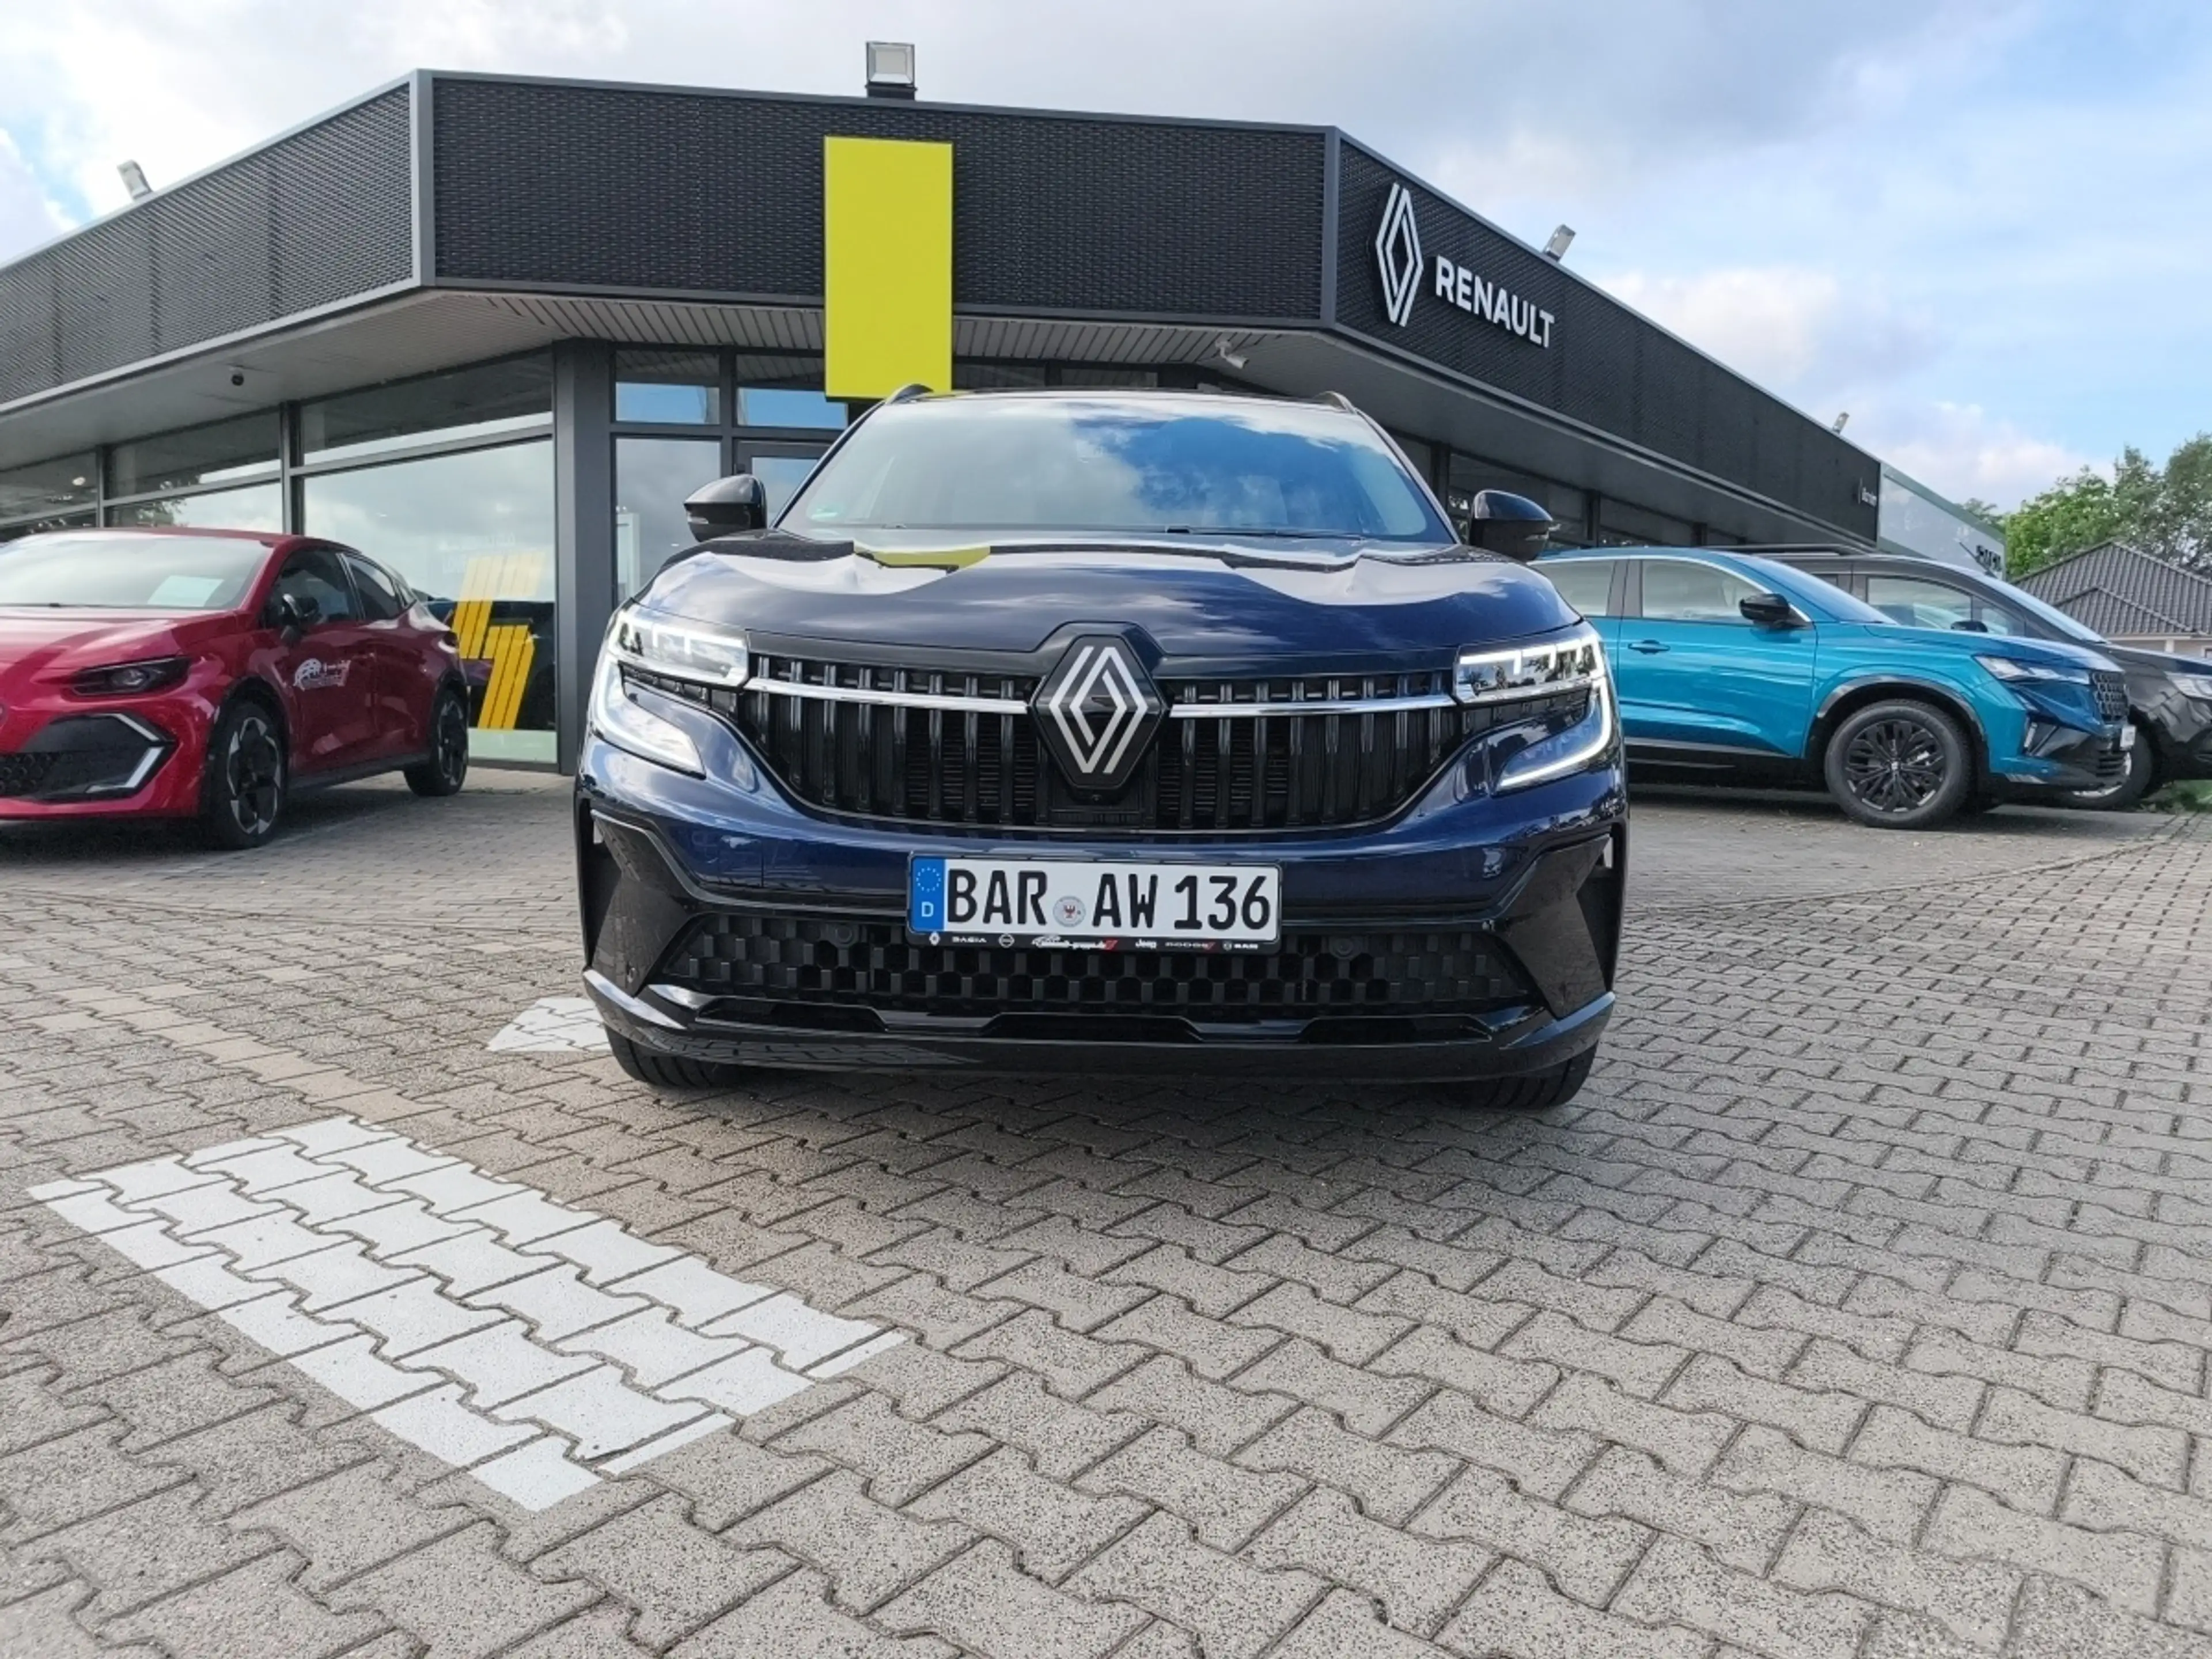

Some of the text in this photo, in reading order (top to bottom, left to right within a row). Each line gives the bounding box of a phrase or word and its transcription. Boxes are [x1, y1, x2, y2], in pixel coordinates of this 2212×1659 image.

[1435, 255, 1555, 349] RENAULT
[921, 902, 934, 917] D
[946, 869, 1271, 930] BAR AW 136
